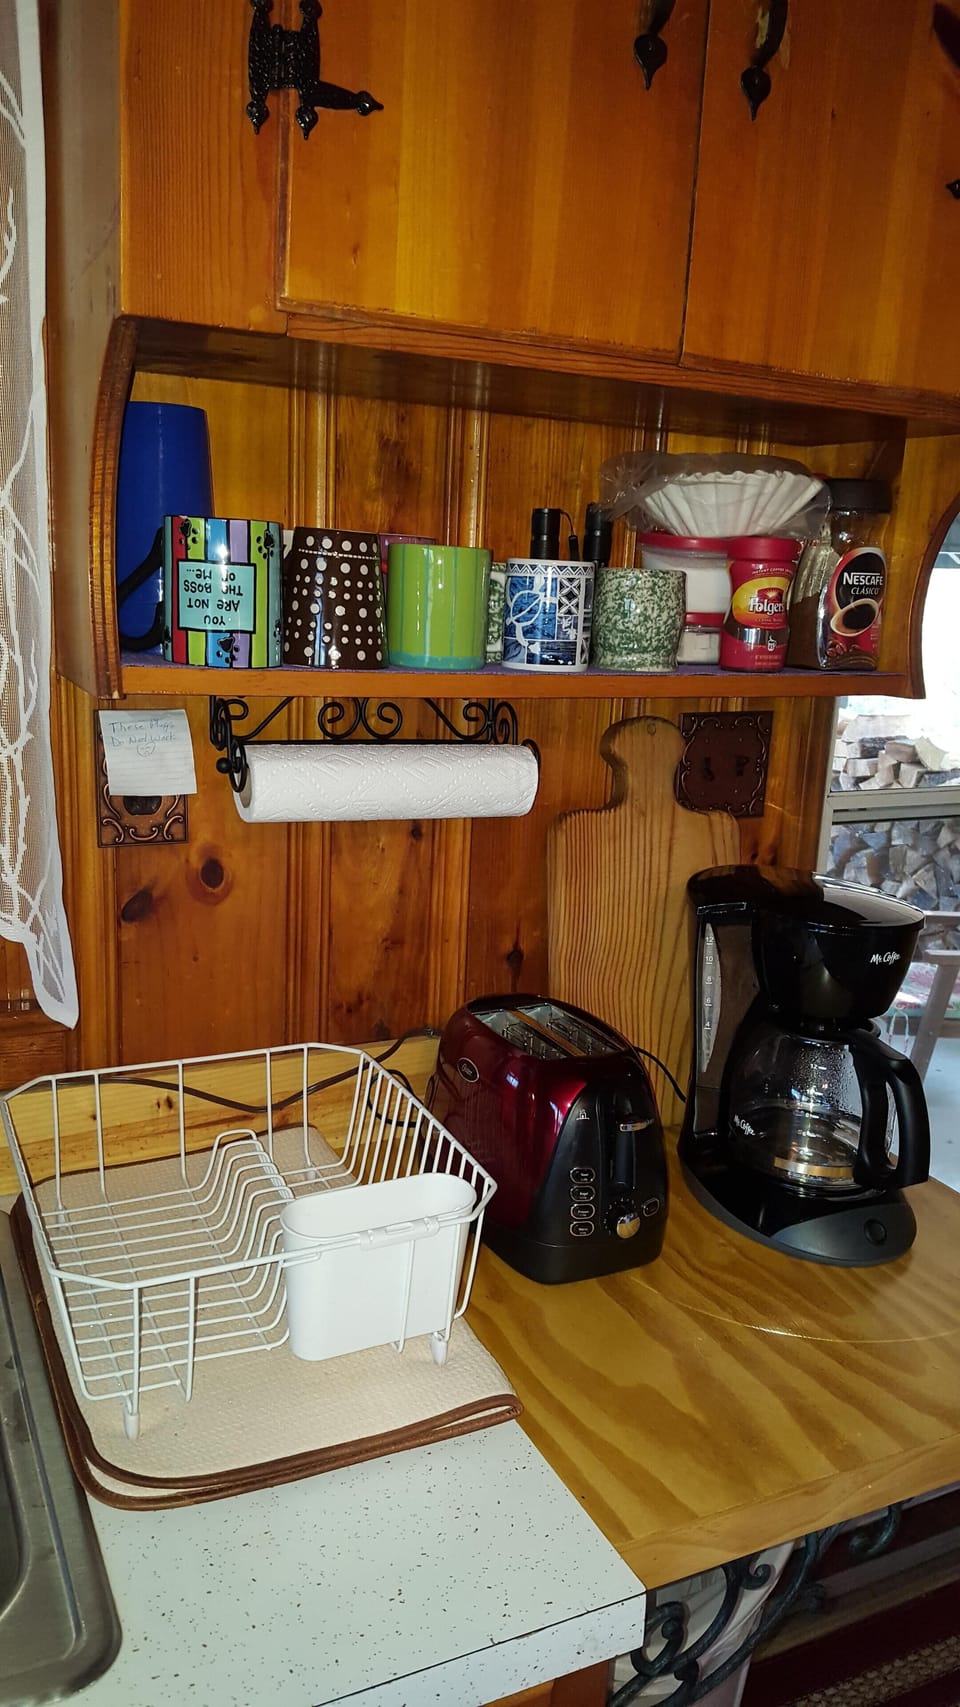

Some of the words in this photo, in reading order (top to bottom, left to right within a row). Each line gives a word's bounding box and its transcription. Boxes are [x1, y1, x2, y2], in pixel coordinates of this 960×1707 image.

[183, 579, 212, 593] BOSS
[186, 598, 209, 609] NOT
[749, 596, 785, 615] Folgers
[203, 615, 226, 626] YOU
[883, 951, 901, 966] Coffee
